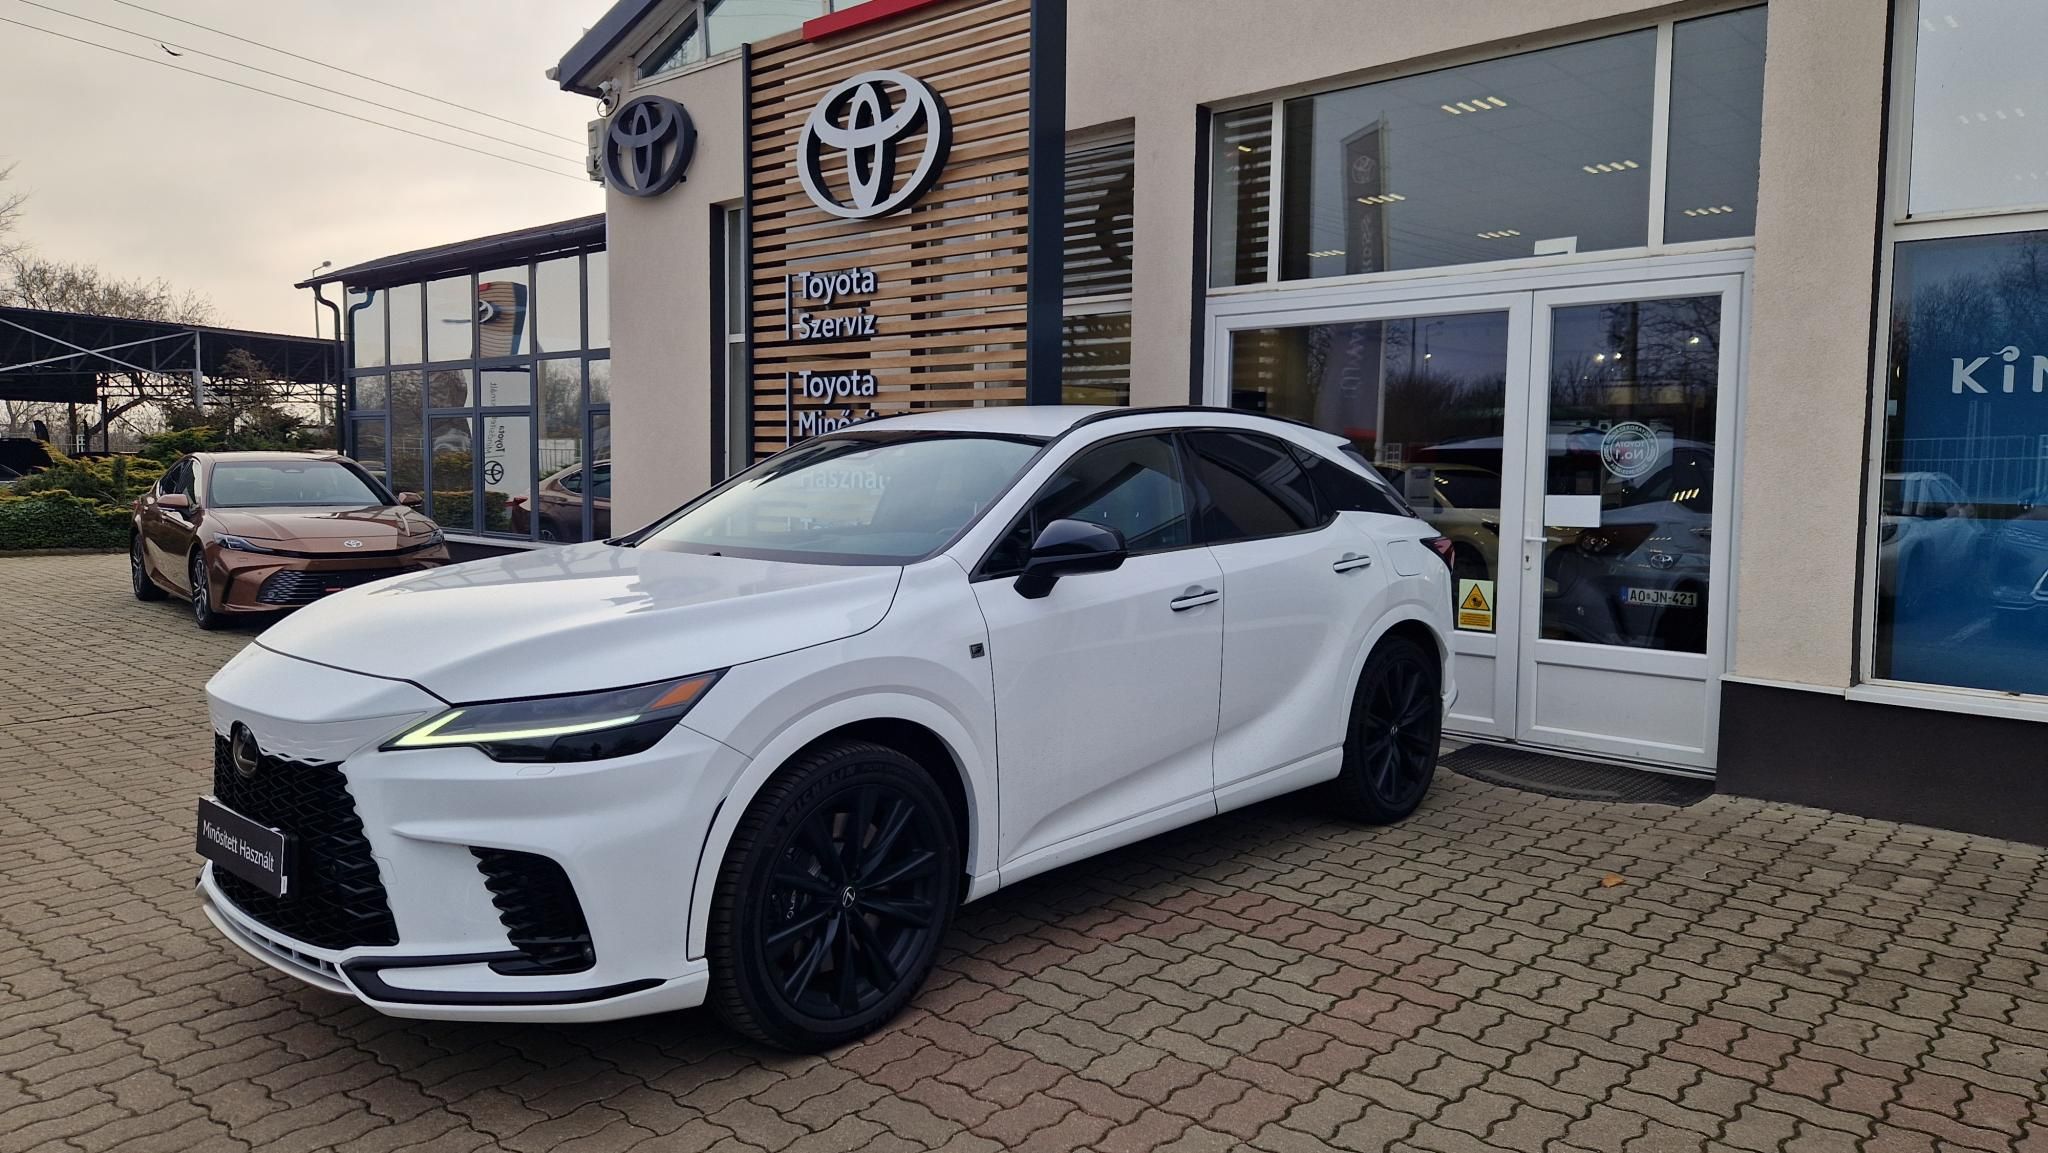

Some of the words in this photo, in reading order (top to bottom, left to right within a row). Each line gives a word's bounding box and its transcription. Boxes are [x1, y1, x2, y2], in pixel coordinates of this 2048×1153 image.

[798, 267, 875, 304] Toyota
[799, 307, 876, 339] Szerviz
[798, 369, 875, 404] Toyota
[239, 838, 275, 873] Használt
